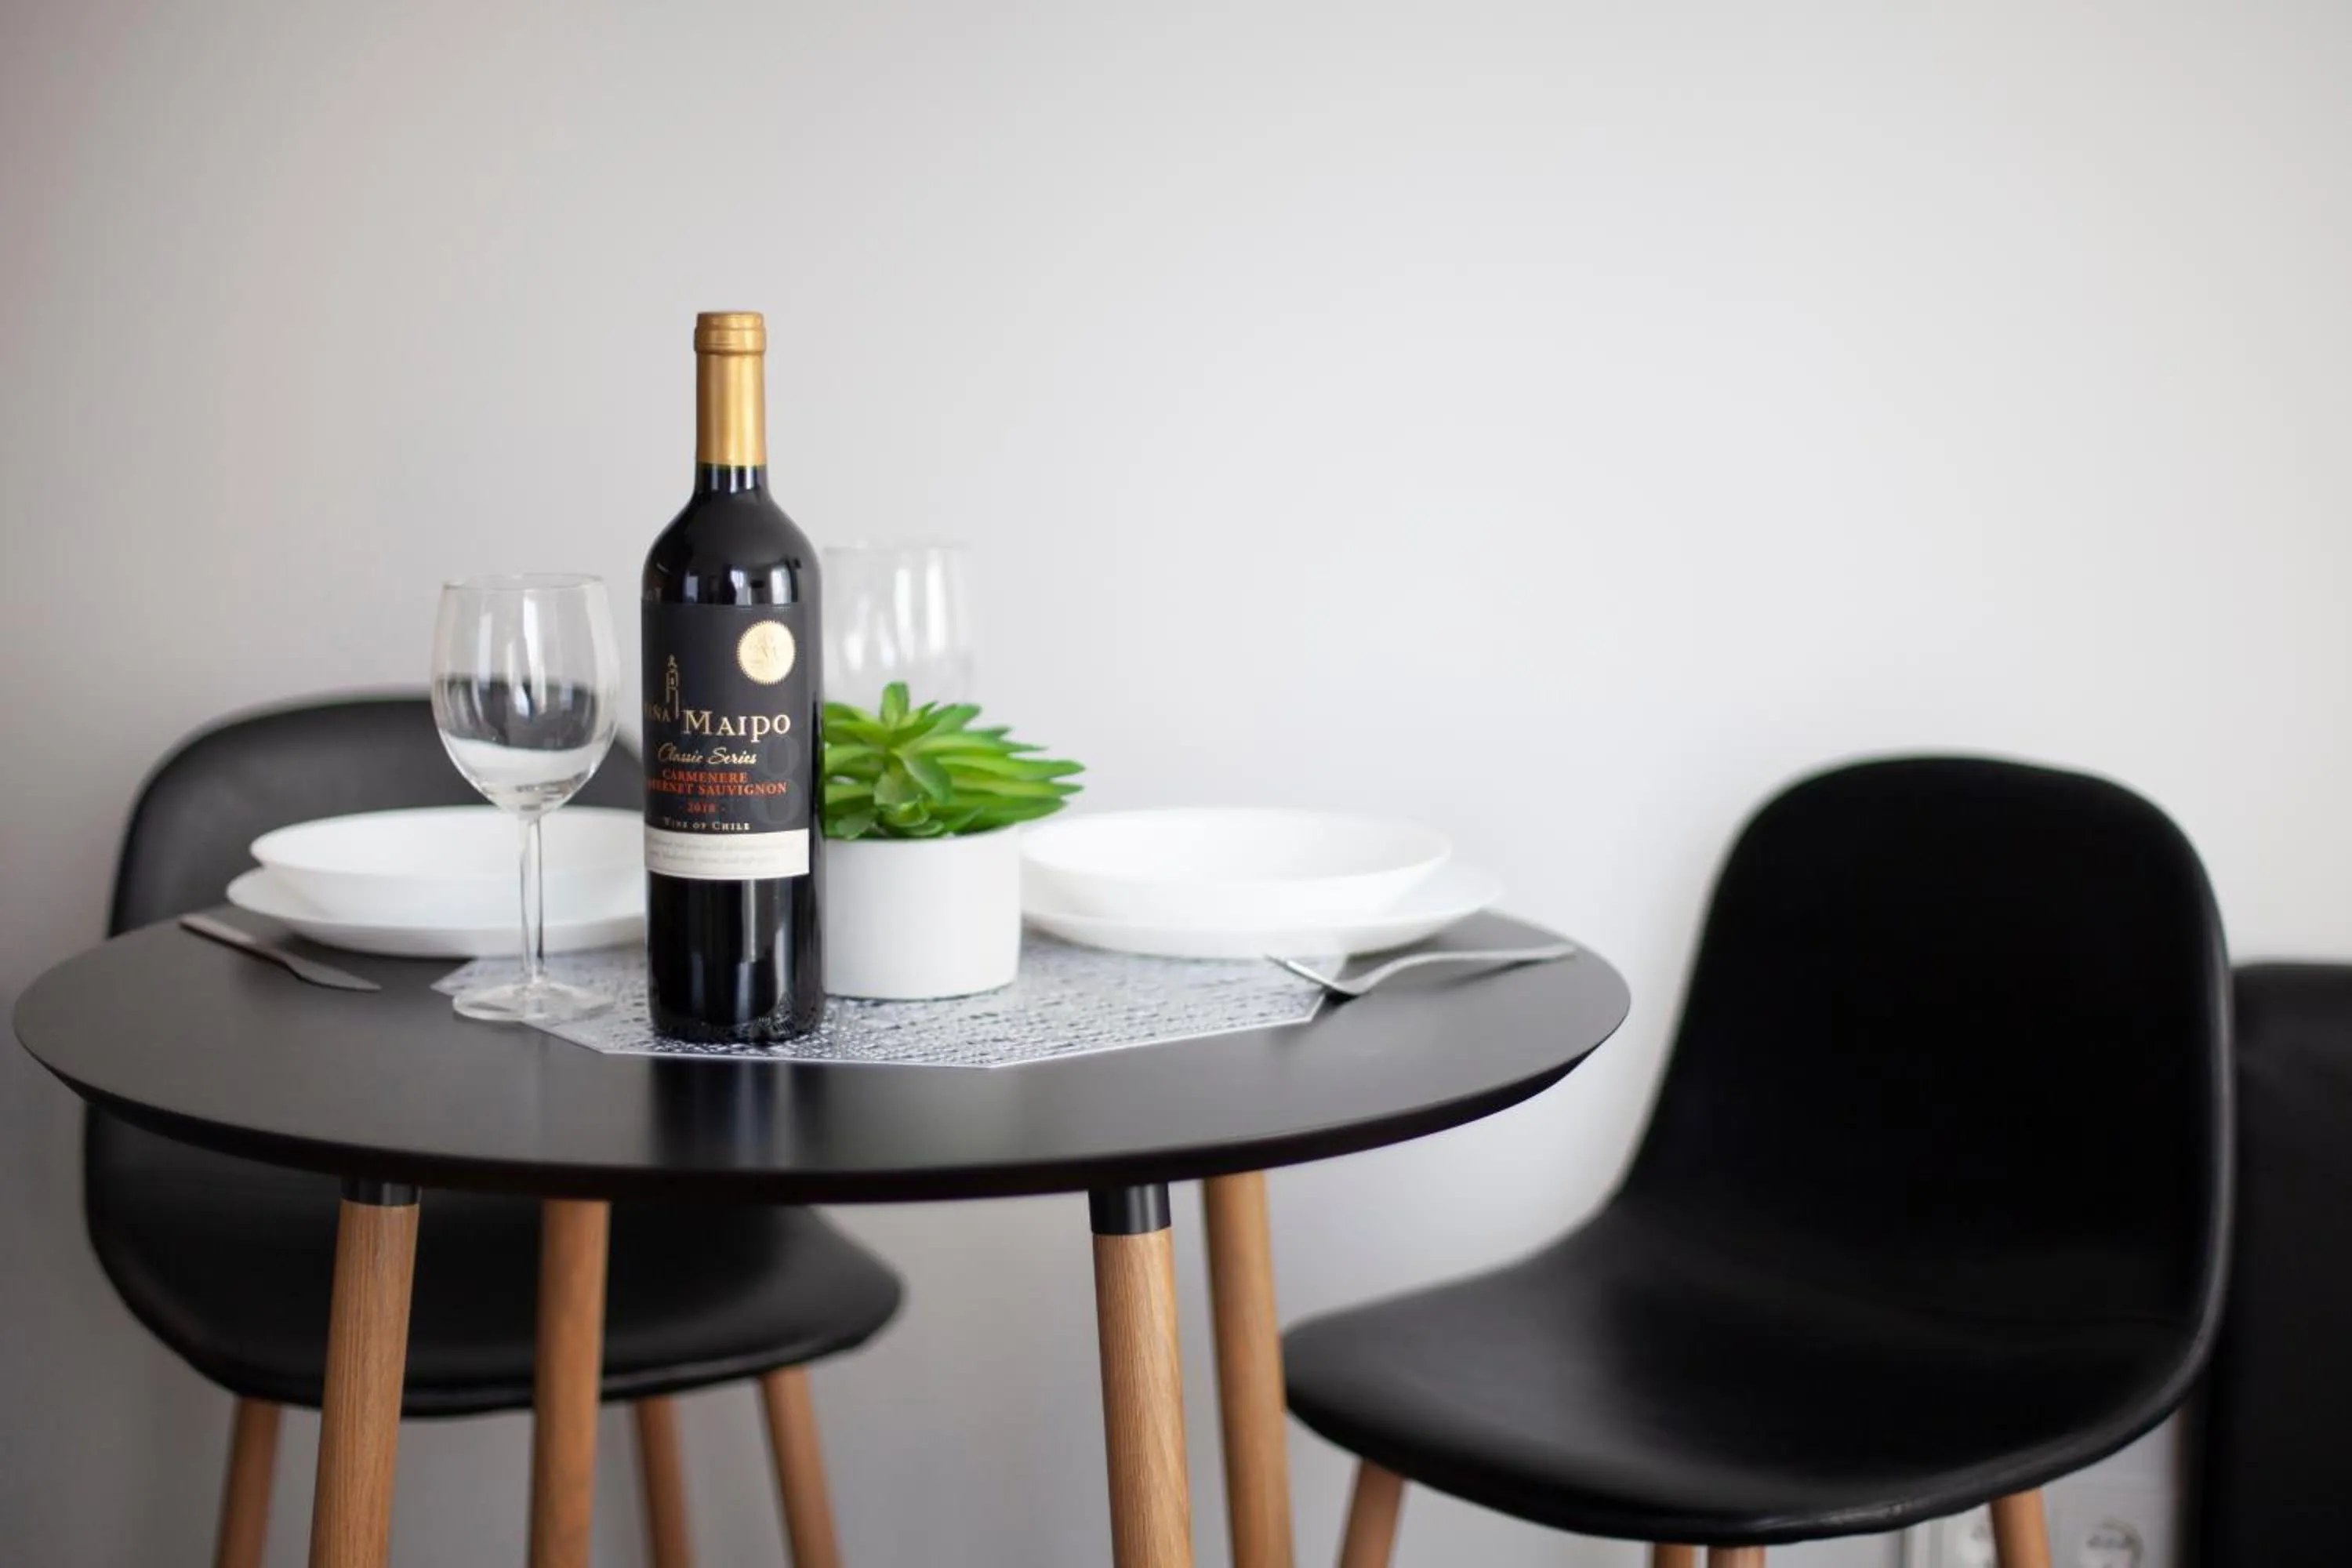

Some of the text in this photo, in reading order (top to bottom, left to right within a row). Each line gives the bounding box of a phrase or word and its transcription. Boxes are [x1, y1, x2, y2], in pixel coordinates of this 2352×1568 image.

[658, 742, 758, 765] Classic Series
[698, 781, 787, 796] SAUVIGNON
